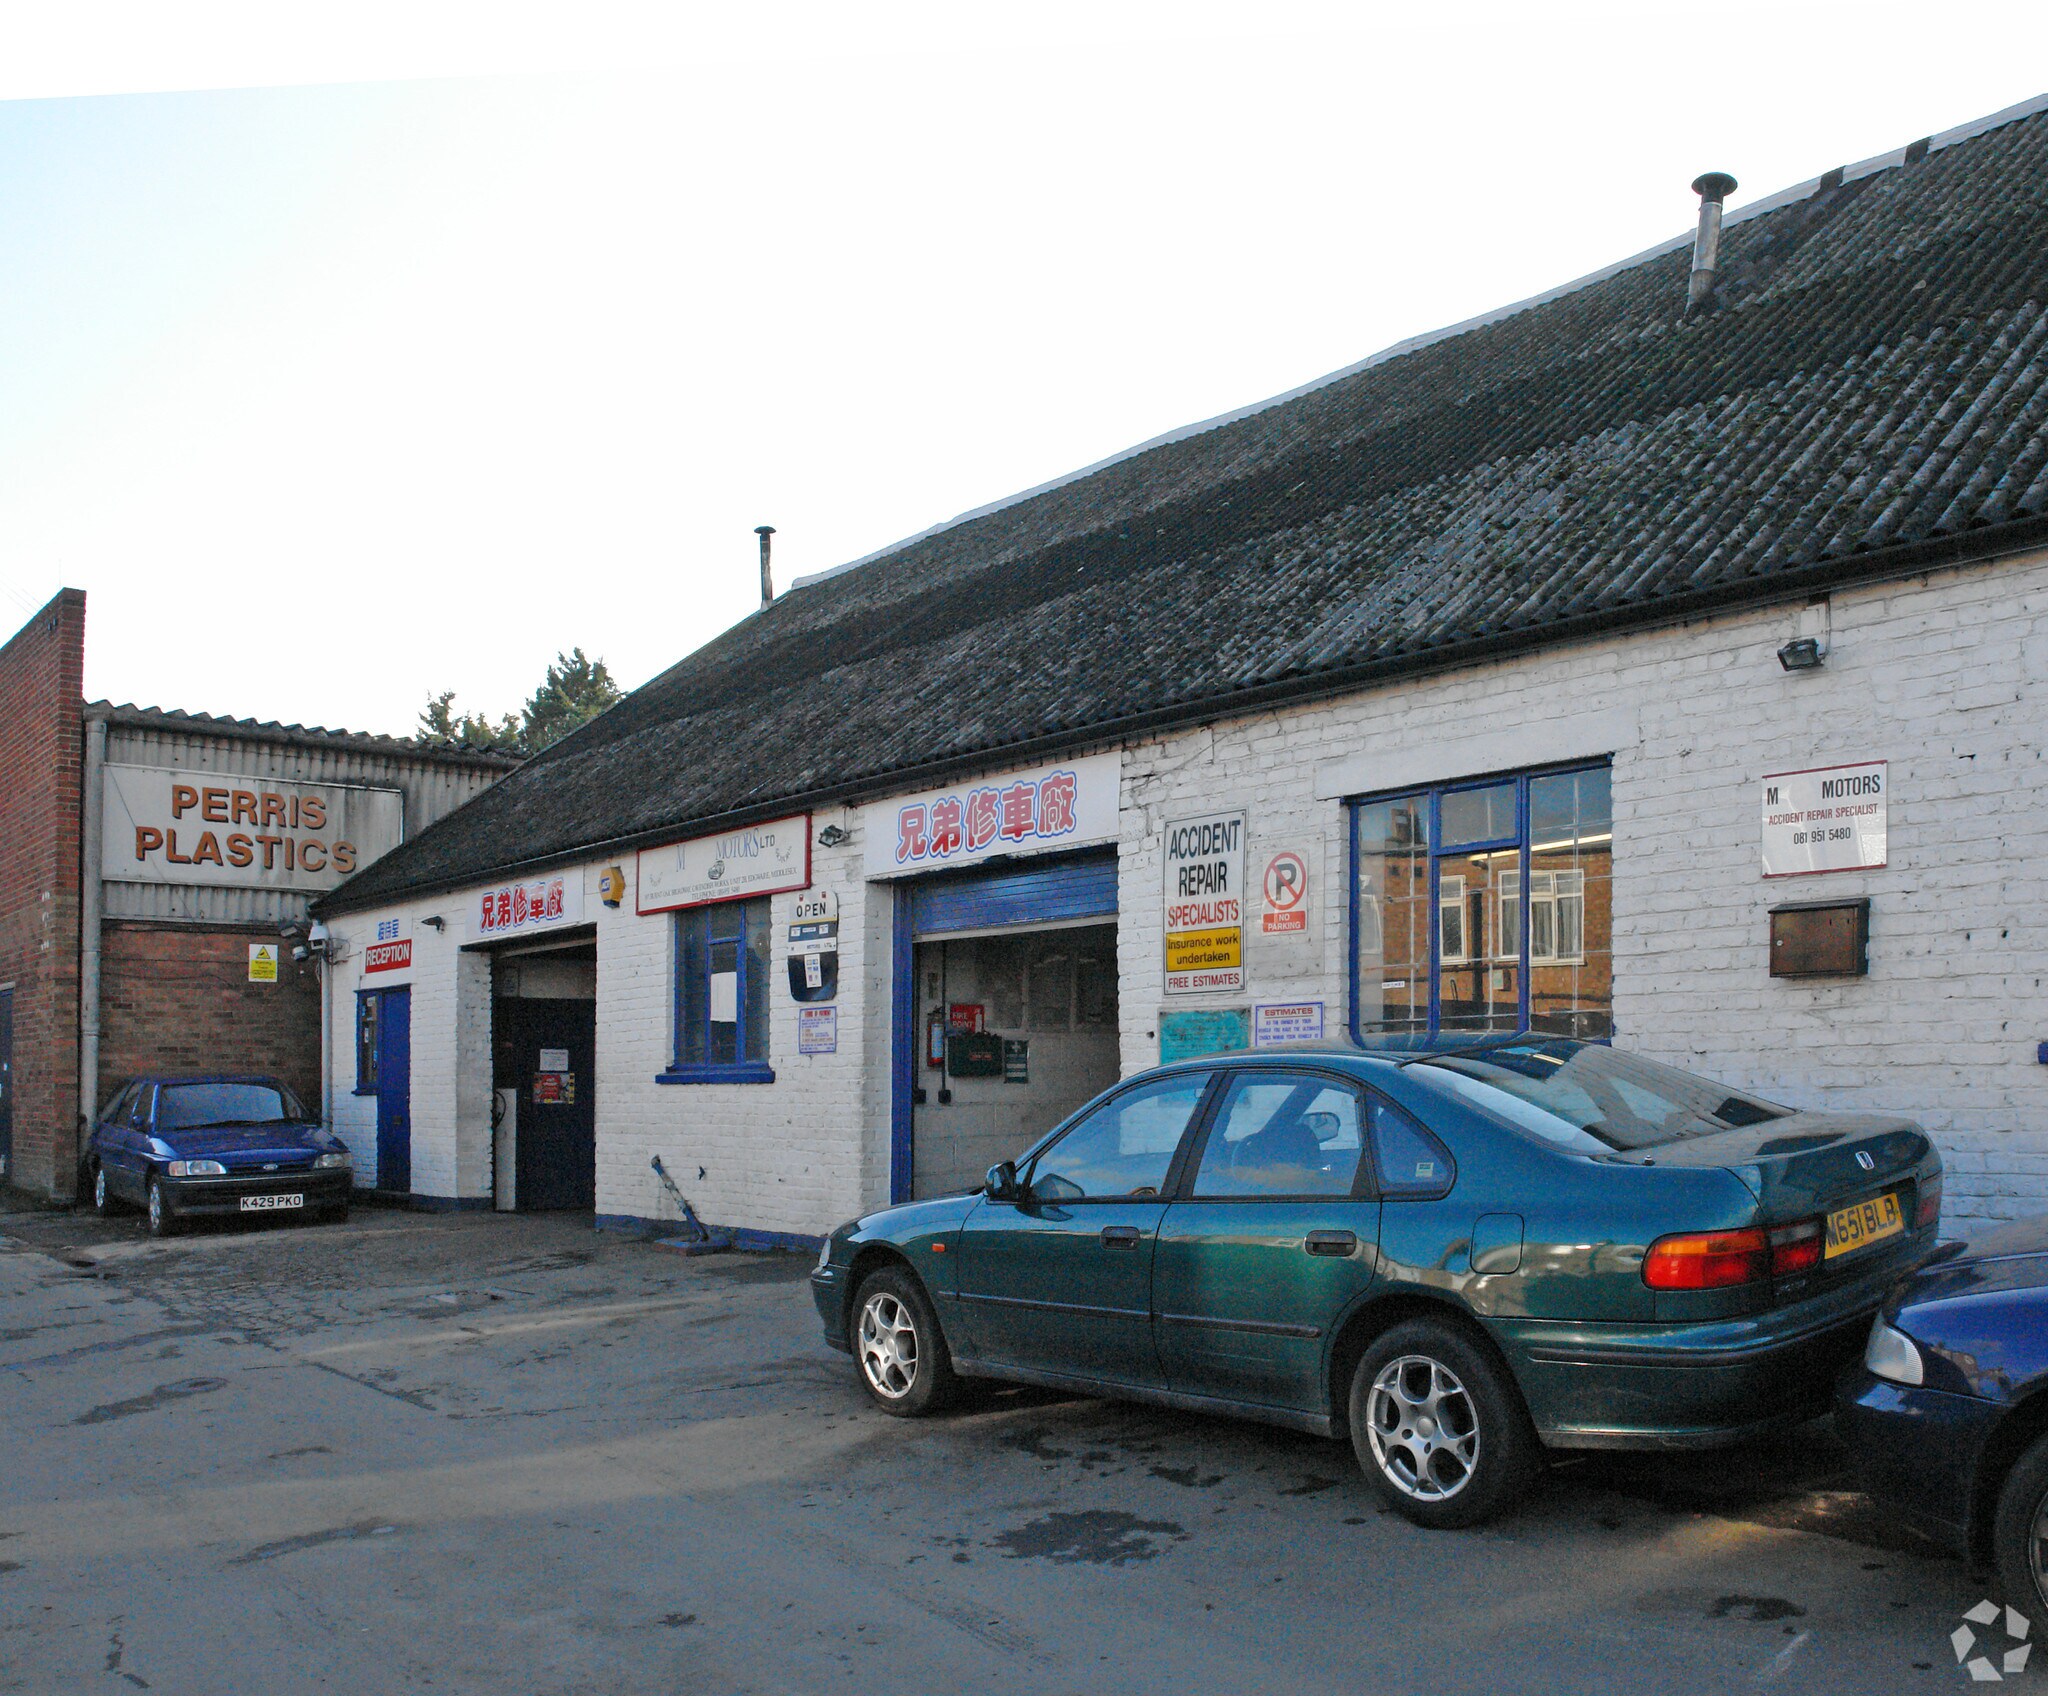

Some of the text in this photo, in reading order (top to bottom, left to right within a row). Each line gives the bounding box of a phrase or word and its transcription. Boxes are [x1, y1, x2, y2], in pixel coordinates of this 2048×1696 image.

[1767, 774, 1881, 805] M MOTORS
[172, 784, 327, 830] PERRIS
[895, 770, 1077, 864] 兄弟修車廠
[1768, 803, 1878, 826] ACCIDENT REPAIR SPECIALIST
[1168, 820, 1241, 860] ACCIDENT
[1793, 827, 1851, 845] 081 951 5480
[135, 826, 358, 873] PLASTICS
[676, 844, 687, 872] M
[715, 828, 760, 860] MOTORS
[759, 835, 775, 849] LTD
[1179, 861, 1228, 897] REPAIR
[796, 901, 826, 917] OPEN
[1168, 899, 1239, 927] SPECIALISTS
[1278, 914, 1290, 922] NO
[1267, 921, 1301, 931] PARKING
[1168, 933, 1239, 950] Insurance work
[367, 943, 410, 966] RECEPTION
[1176, 951, 1230, 964] undertaken
[1168, 973, 1240, 988] FREE ESTIMATES
[1264, 1007, 1313, 1017] ESTIMATES
[242, 1195, 301, 1209] K429 PKO
